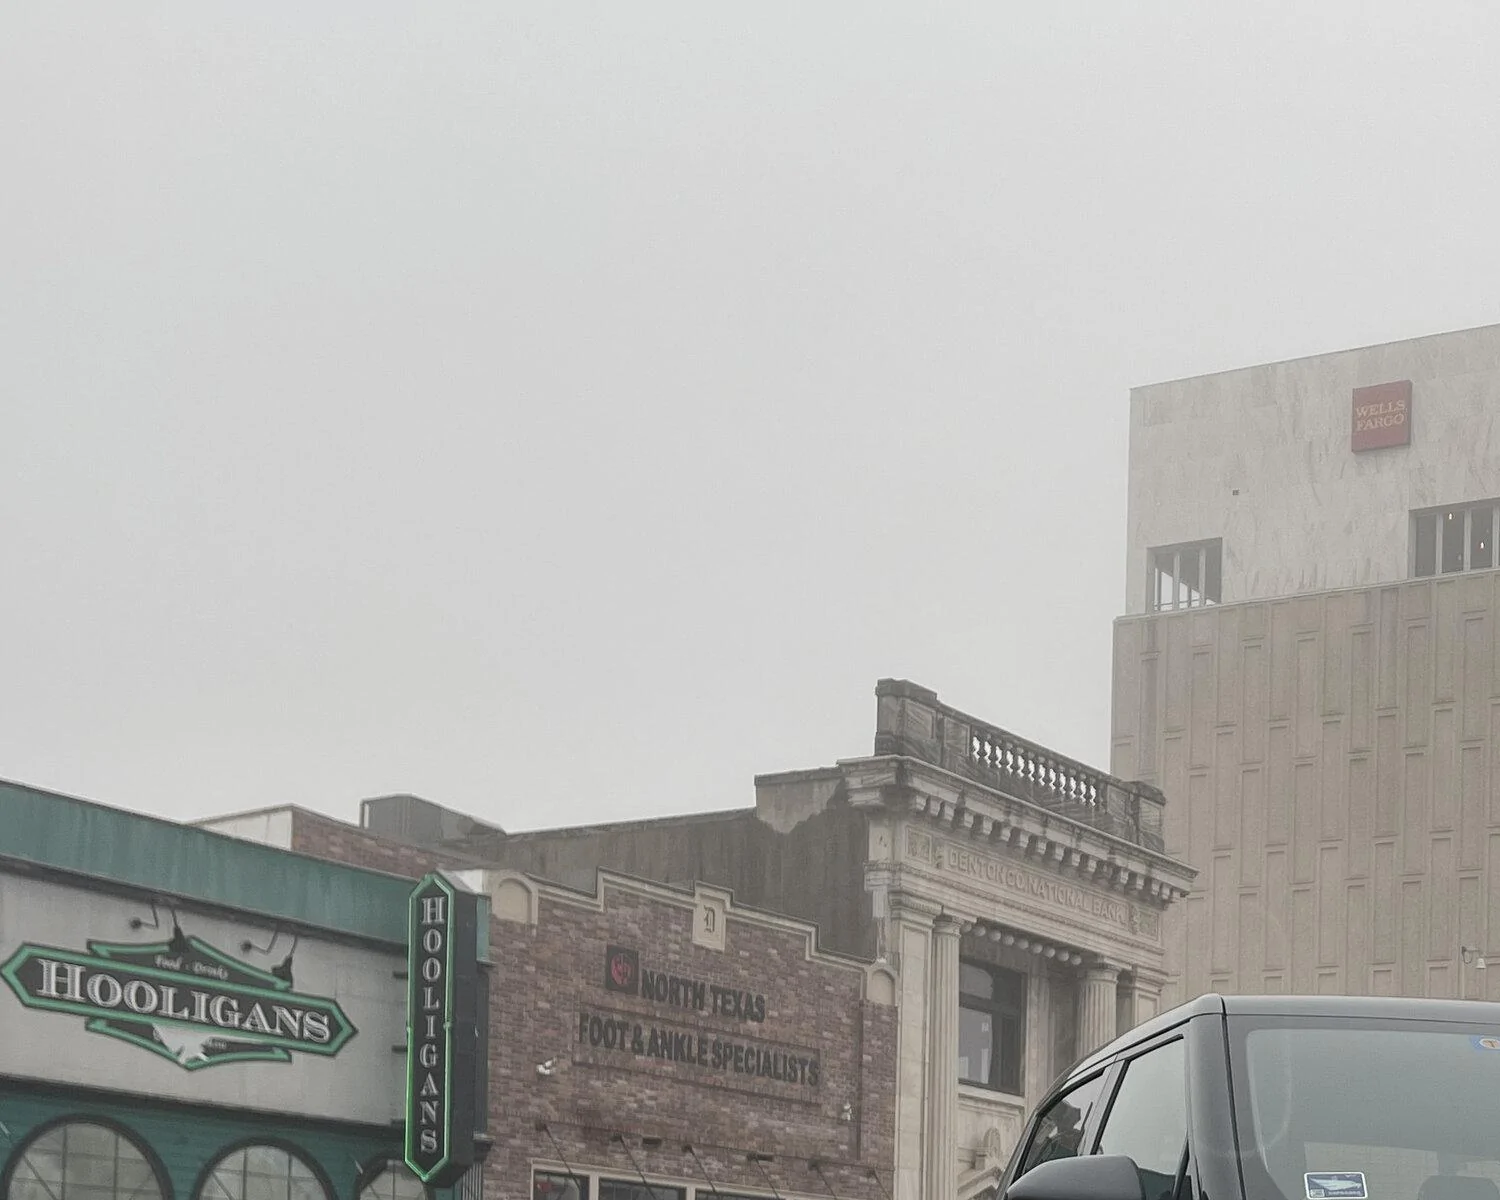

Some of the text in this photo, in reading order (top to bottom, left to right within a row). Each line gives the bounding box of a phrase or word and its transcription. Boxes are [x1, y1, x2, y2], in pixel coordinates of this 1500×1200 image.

[1355, 400, 1405, 418] WELLS
[1356, 413, 1405, 431] FARGO
[36, 958, 332, 1044] HOOLIGANS
[418, 896, 446, 1154] HOOLIGANS
[641, 968, 766, 1023] NORTH TEXAS
[578, 1012, 820, 1087] FOOT & ANKLE SPECIALISTS
